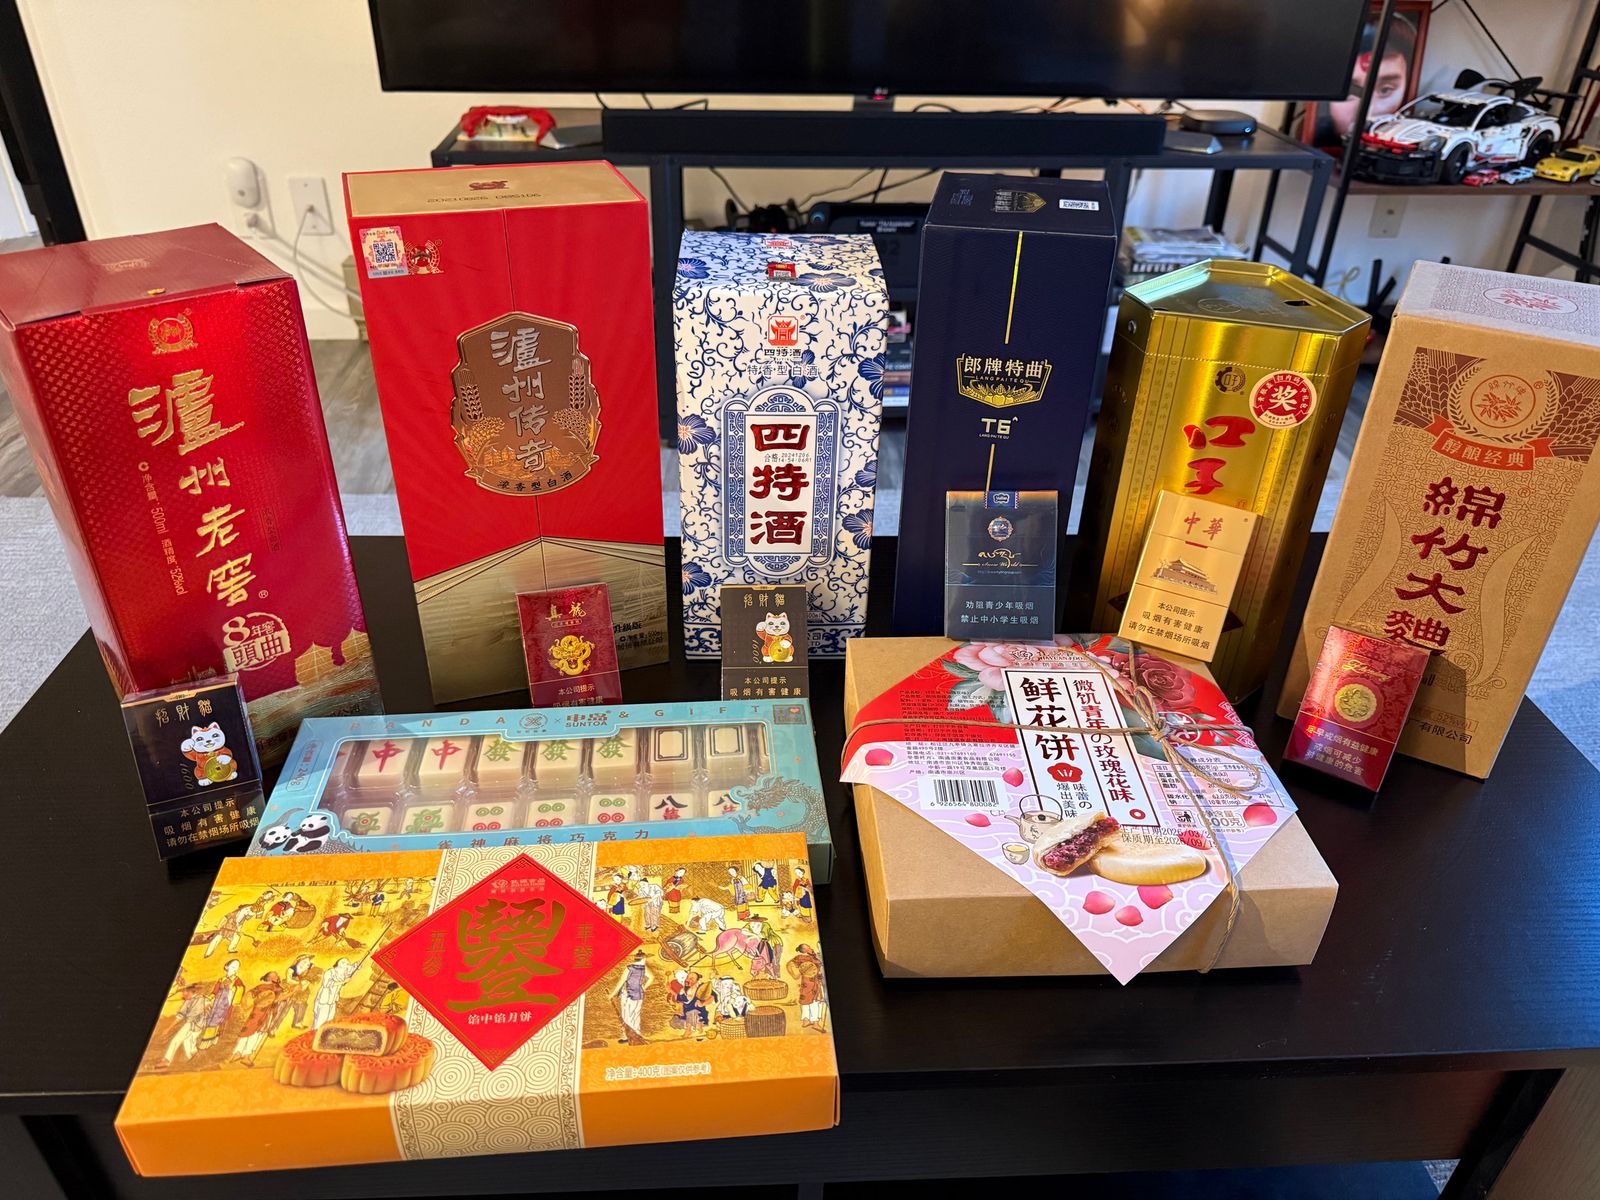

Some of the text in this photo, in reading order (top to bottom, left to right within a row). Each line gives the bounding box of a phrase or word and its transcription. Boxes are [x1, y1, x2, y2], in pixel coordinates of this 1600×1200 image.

[764, 348, 801, 357] 四特酒
[747, 365, 818, 376] 特香型白酒
[964, 355, 1044, 379] 郎牌特曲
[1267, 385, 1299, 411] 奖
[498, 470, 573, 491] 浓香型白酒
[749, 423, 811, 545] 四特酒
[1184, 511, 1224, 541] 中華
[965, 601, 1034, 610] 劝阻青少年吸烟
[1158, 601, 1195, 618] 本公司提示
[960, 614, 1039, 625] 禁止中小学生吸烟
[1141, 611, 1203, 634] 吸烟有害健康
[1128, 620, 1210, 650] 请勿在禁烟场所吸烟
[752, 639, 760, 664] 1600
[558, 684, 596, 696] 本公司提示
[729, 687, 802, 697] 吸烟有害健康
[744, 676, 787, 685] 本公司提示
[565, 720, 608, 728] SUNTOA
[1020, 677, 1080, 761] 鲜花饼
[1073, 679, 1135, 804] 微饥青年の玫瑰花味
[372, 740, 405, 773] 中
[431, 738, 464, 770] 中
[1056, 782, 1078, 818] 爆出美味
[1073, 783, 1093, 809] 味蕾の
[180, 798, 235, 818] 本公司提示
[164, 806, 257, 836] 吸烟有害健康
[1210, 817, 1243, 826] 00克
[166, 818, 260, 848] 请勿在禁烟场所吸烟
[467, 1010, 532, 1025] 馅中馅月饼
